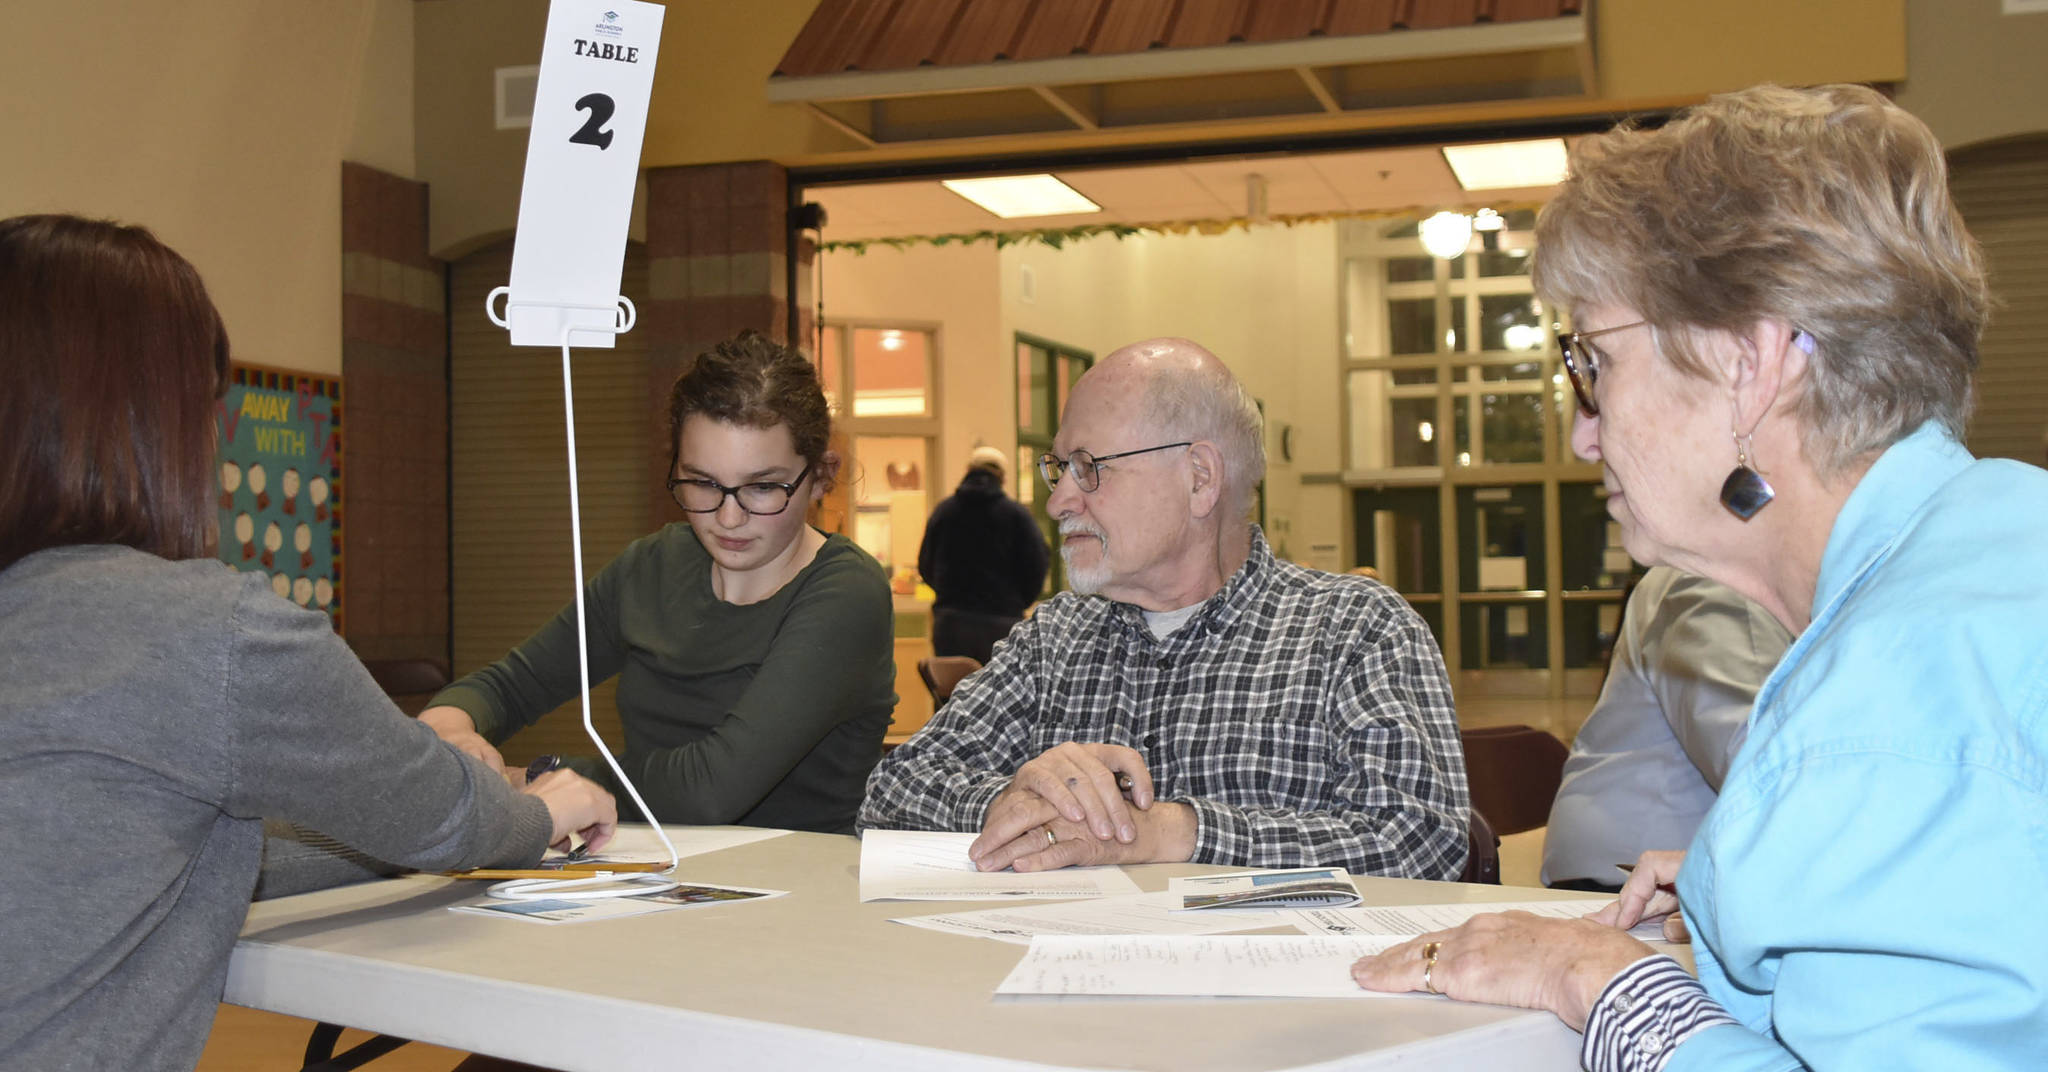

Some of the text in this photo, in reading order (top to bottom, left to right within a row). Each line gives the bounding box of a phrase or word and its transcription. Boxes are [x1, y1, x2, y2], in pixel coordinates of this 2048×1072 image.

[574, 39, 639, 63] TABLE
[569, 93, 615, 151] 2
[241, 392, 290, 422] AWAY
[254, 427, 305, 456] WITH
